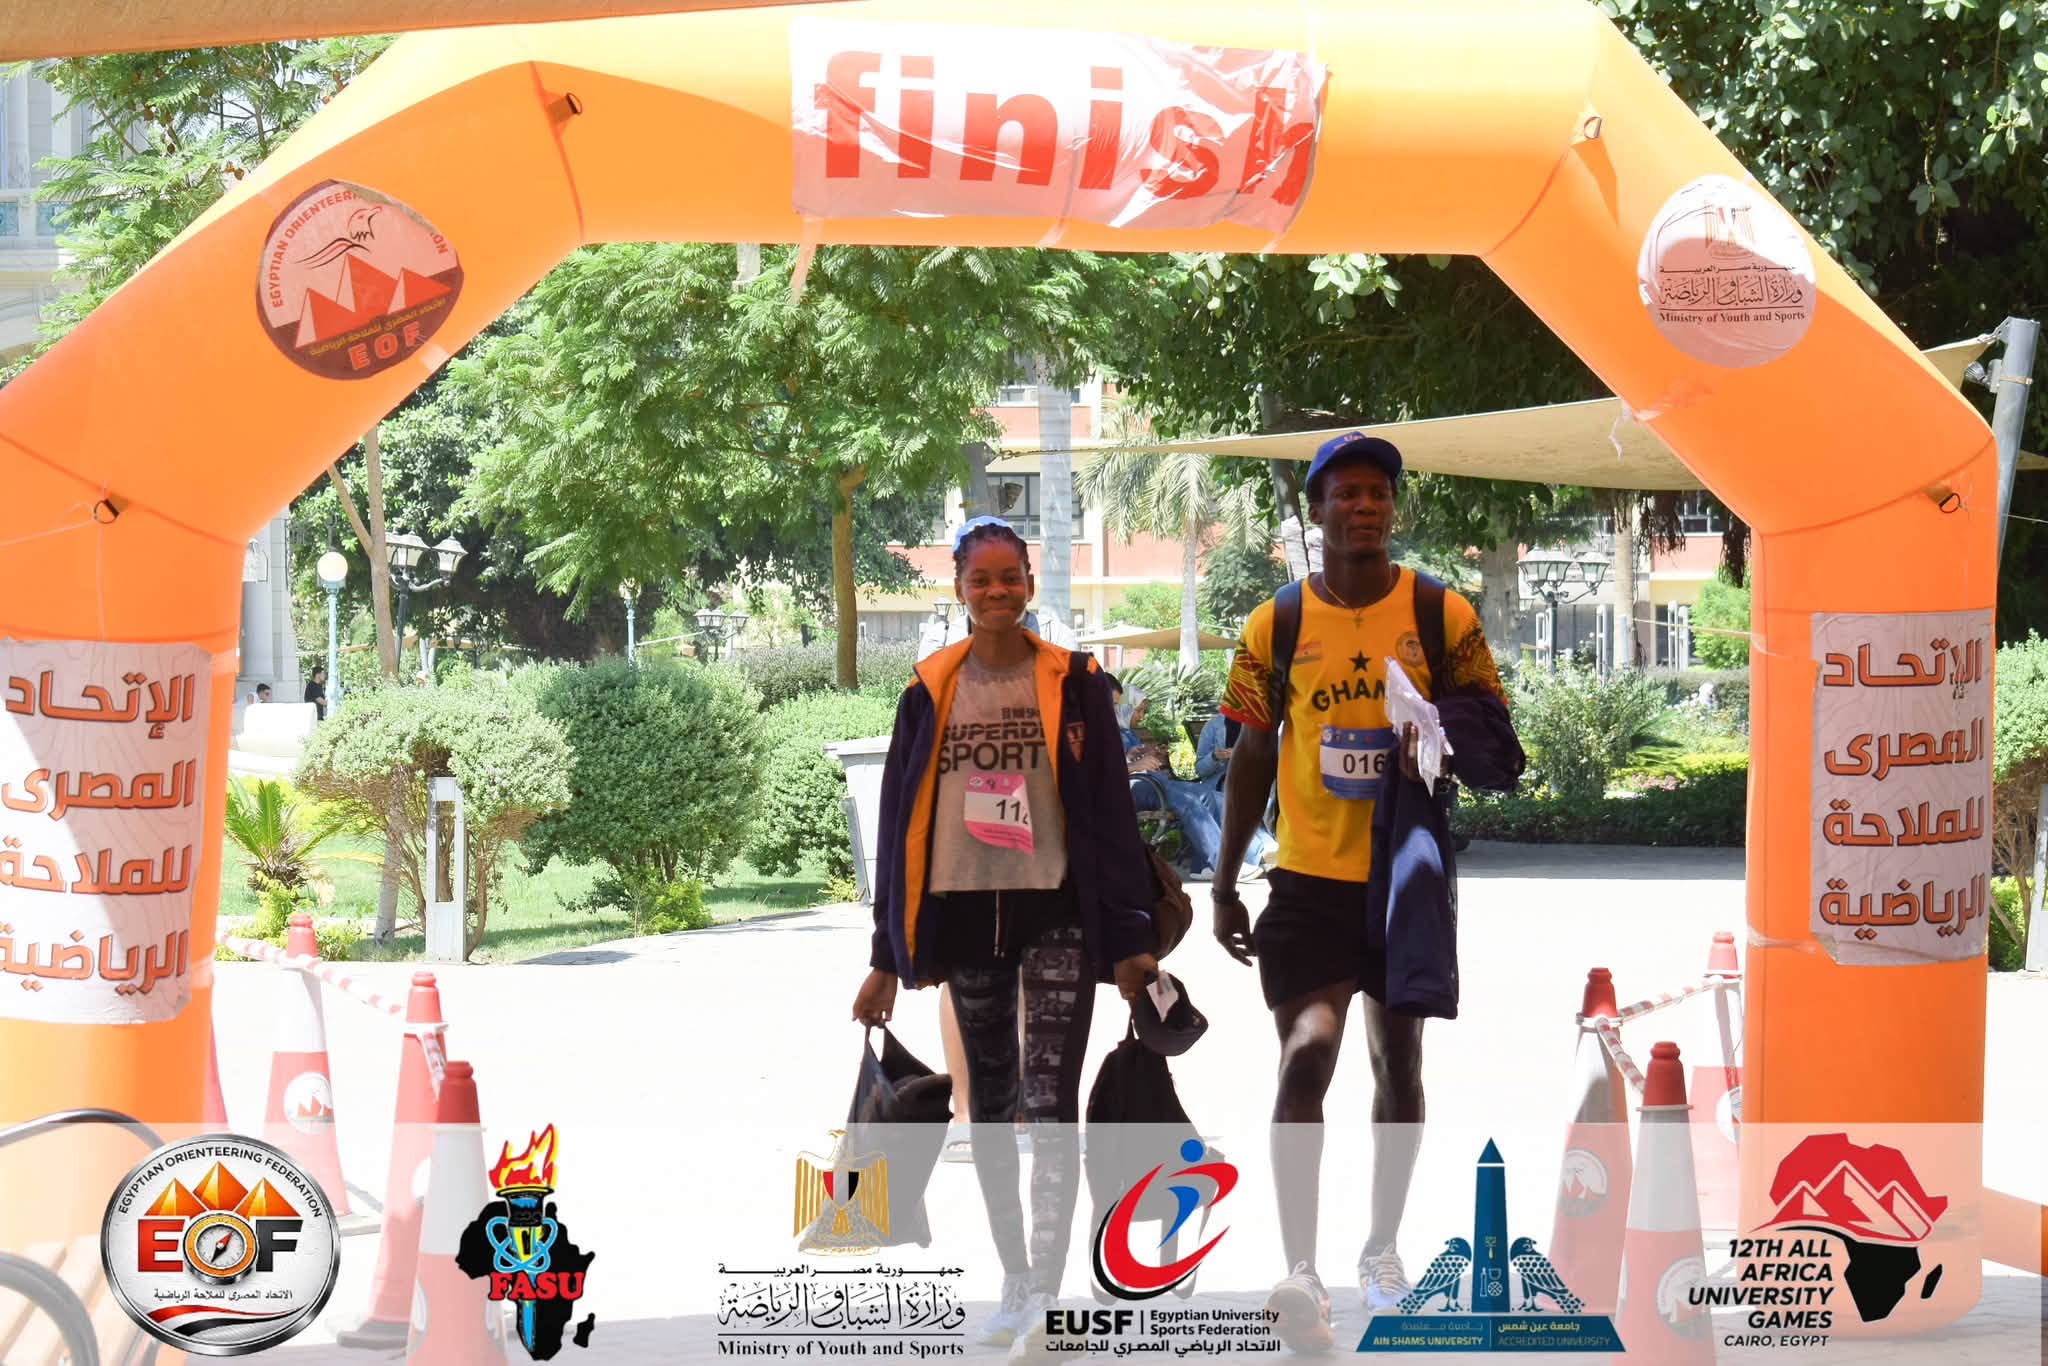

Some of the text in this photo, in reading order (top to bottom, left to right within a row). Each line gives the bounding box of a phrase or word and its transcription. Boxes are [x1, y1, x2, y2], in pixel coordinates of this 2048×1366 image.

[814, 50, 1314, 206] finish
[268, 190, 362, 308] EGYPTIAN ORIENTEER
[348, 321, 420, 371] EOF
[1659, 310, 1805, 324] Ministry of Youth and Sports
[1312, 678, 1386, 712] GHAN
[1823, 638, 1983, 700] الإتحاد
[6, 670, 195, 740] الإتحاد
[937, 741, 1046, 774] SPORT
[1343, 753, 1386, 774] 016
[1824, 717, 1985, 781] المصرى
[1, 758, 196, 822] المصرى
[1823, 796, 1985, 848] للملاحة
[0, 834, 192, 896] للملاحة
[1820, 873, 1986, 940] الرياضية
